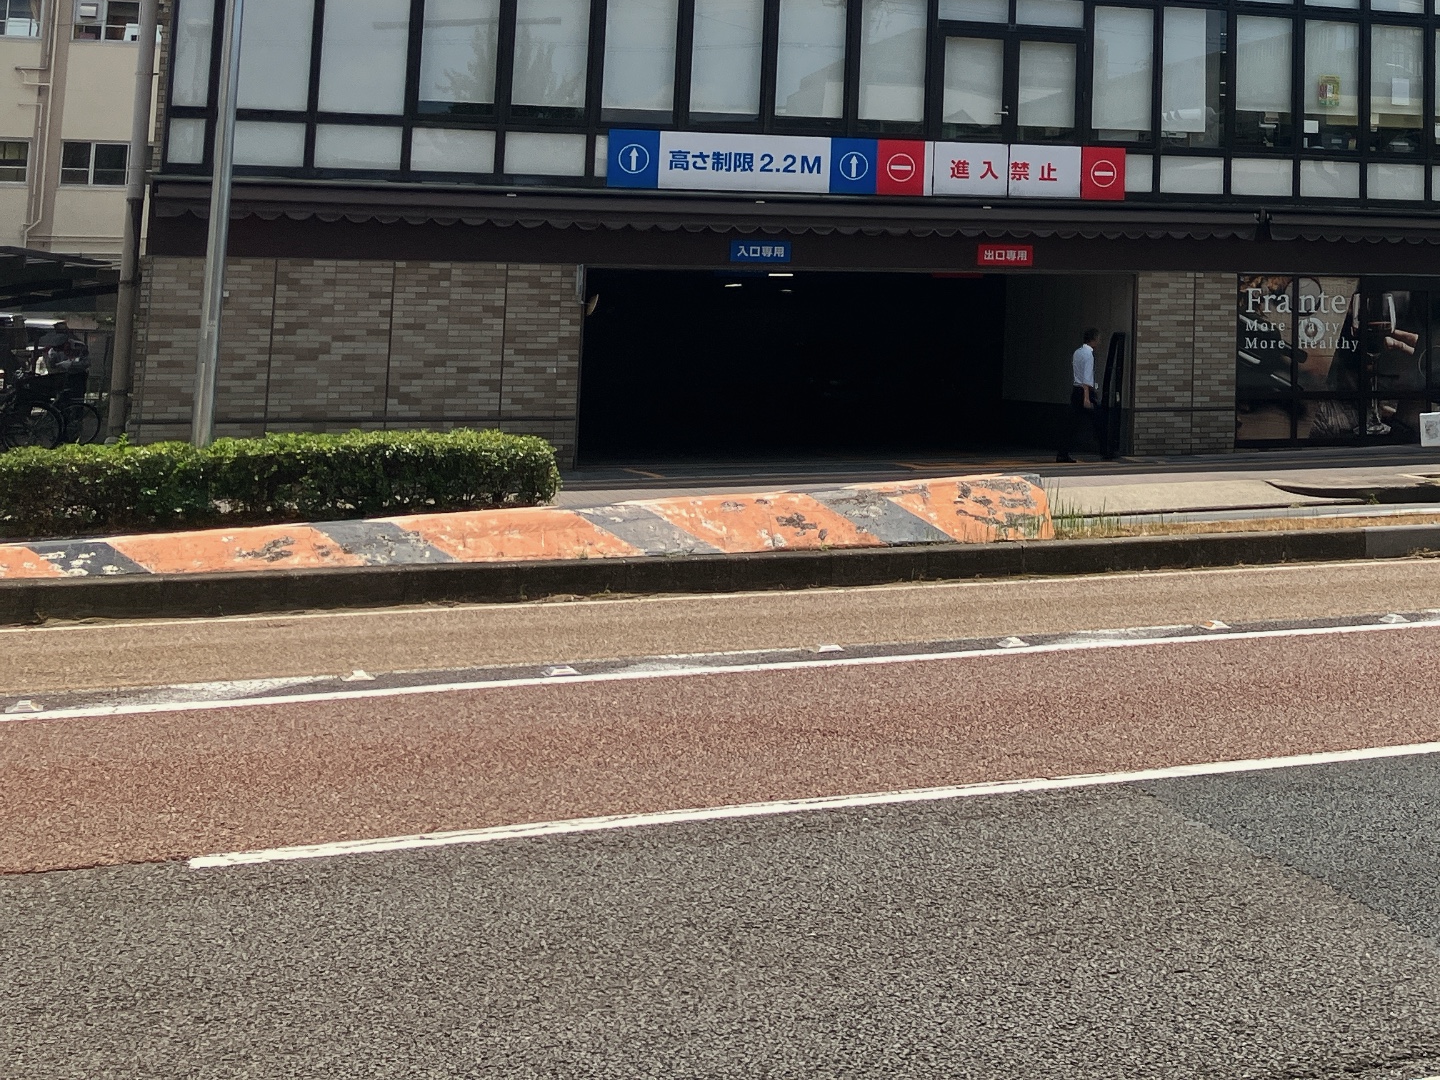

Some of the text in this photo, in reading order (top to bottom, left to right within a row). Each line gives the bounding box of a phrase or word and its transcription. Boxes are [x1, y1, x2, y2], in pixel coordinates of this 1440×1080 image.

[669, 150, 822, 175] 高さ制限2.2M
[950, 160, 1058, 182] 進入禁止
[737, 245, 785, 258] 入口専用
[983, 249, 1028, 261] 出口専用
[1245, 287, 1348, 314] Frante
[1245, 319, 1286, 332] More
[1244, 337, 1359, 352] More Healthy
